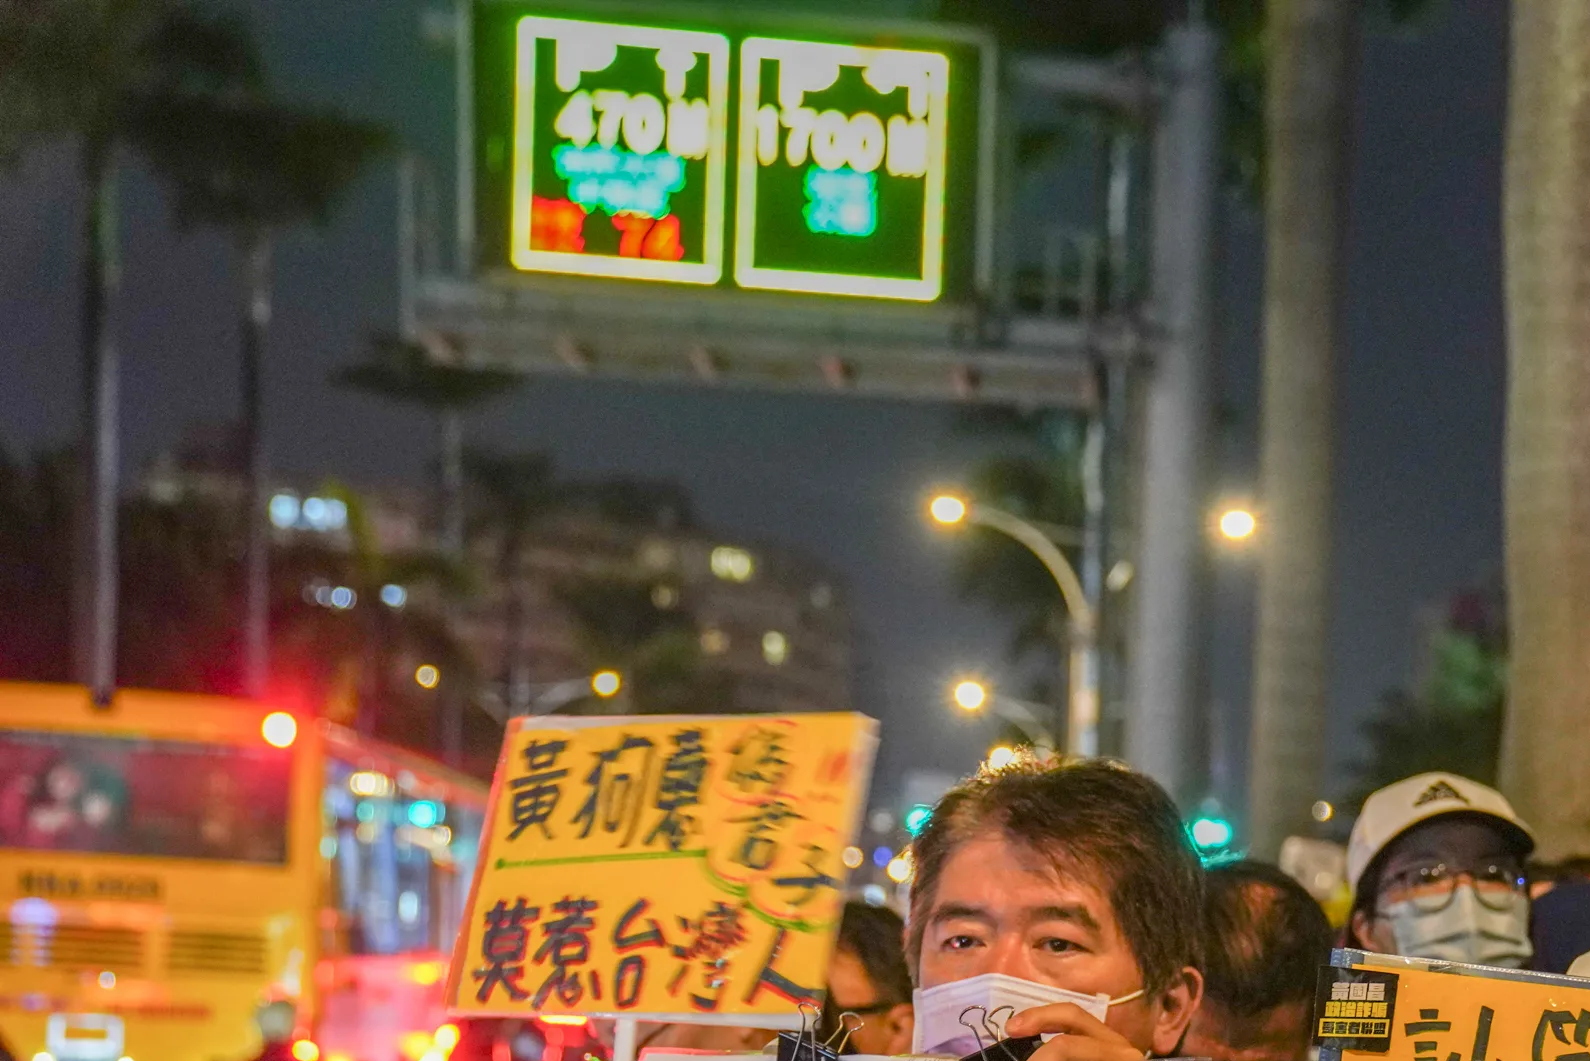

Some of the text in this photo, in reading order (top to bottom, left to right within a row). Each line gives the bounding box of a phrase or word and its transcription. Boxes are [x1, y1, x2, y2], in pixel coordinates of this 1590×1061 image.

[470, 898, 828, 1012] 莫惹台灣人
